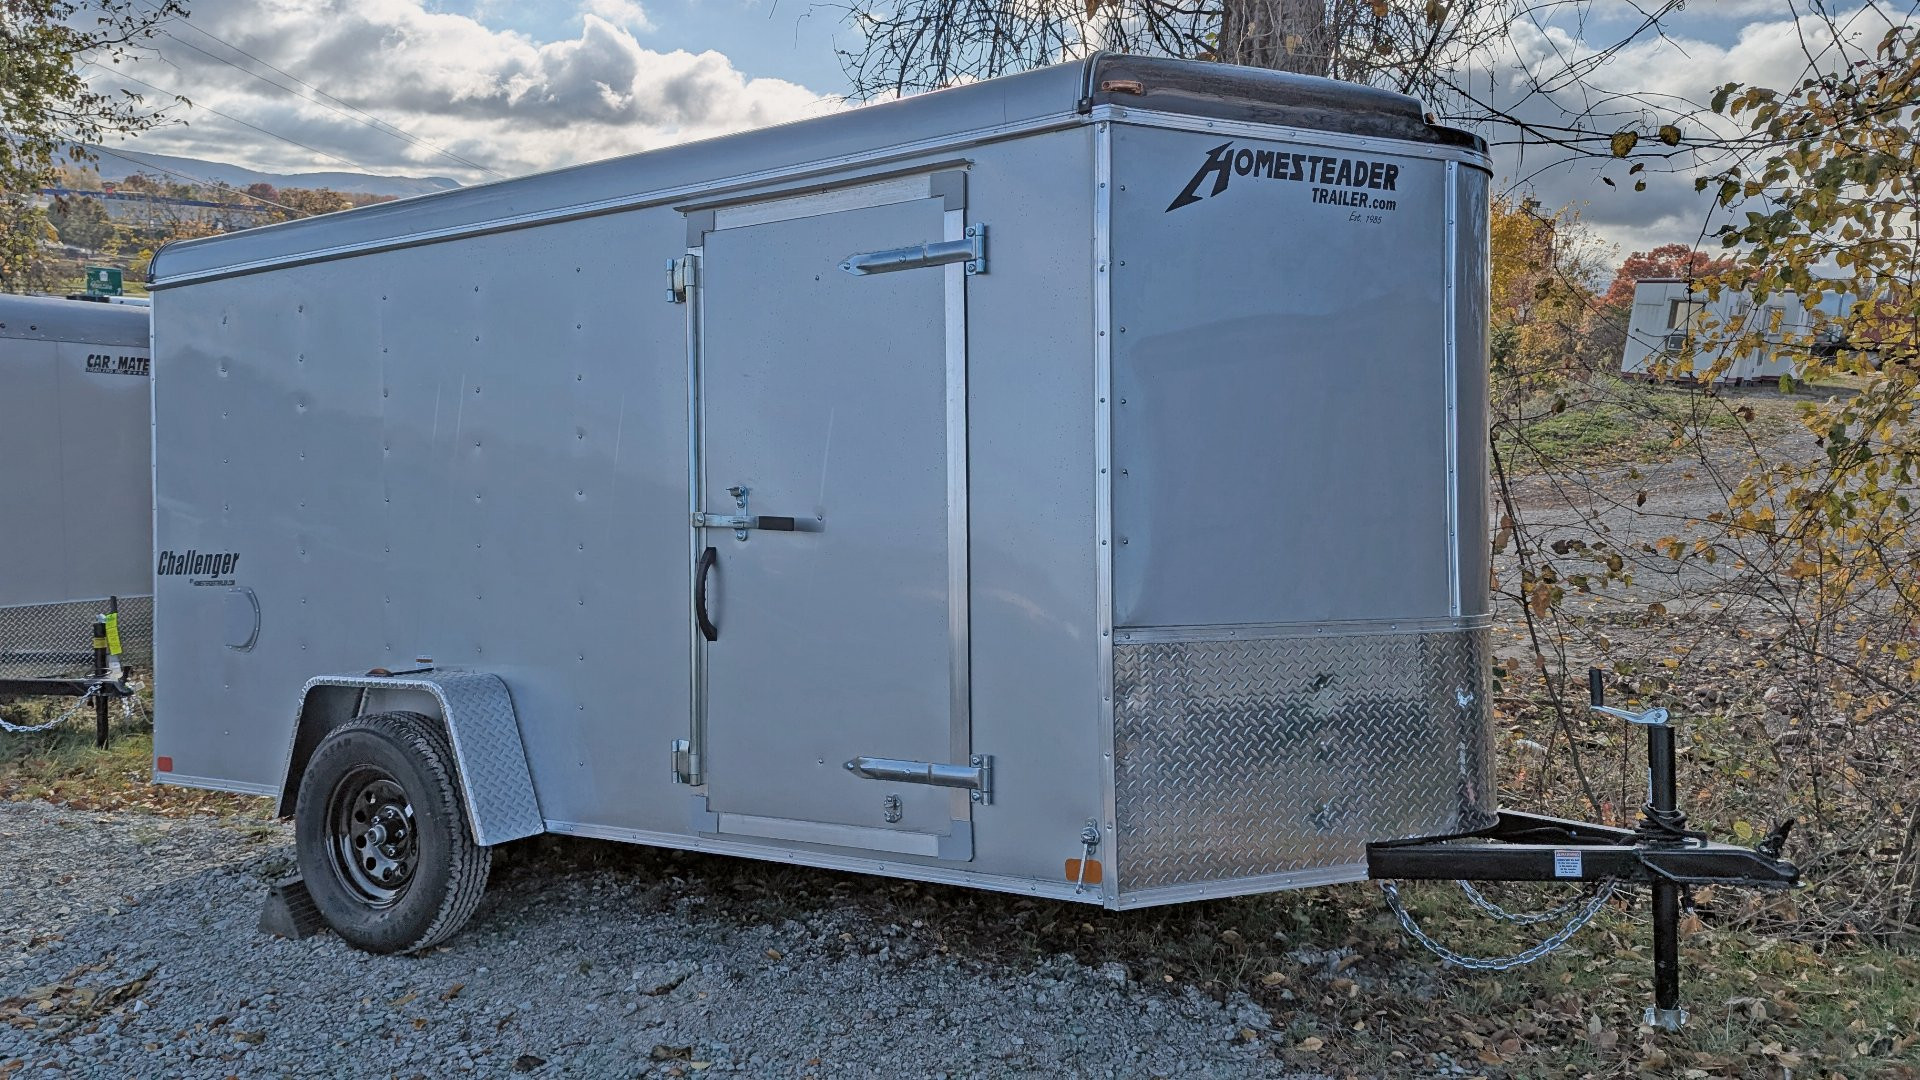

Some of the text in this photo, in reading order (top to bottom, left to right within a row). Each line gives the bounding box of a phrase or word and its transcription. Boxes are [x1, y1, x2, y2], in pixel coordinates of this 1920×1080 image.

[1165, 140, 1399, 213] HOMESTEADER
[1311, 187, 1396, 211] TRAILER.com
[157, 549, 241, 579] Challenger
